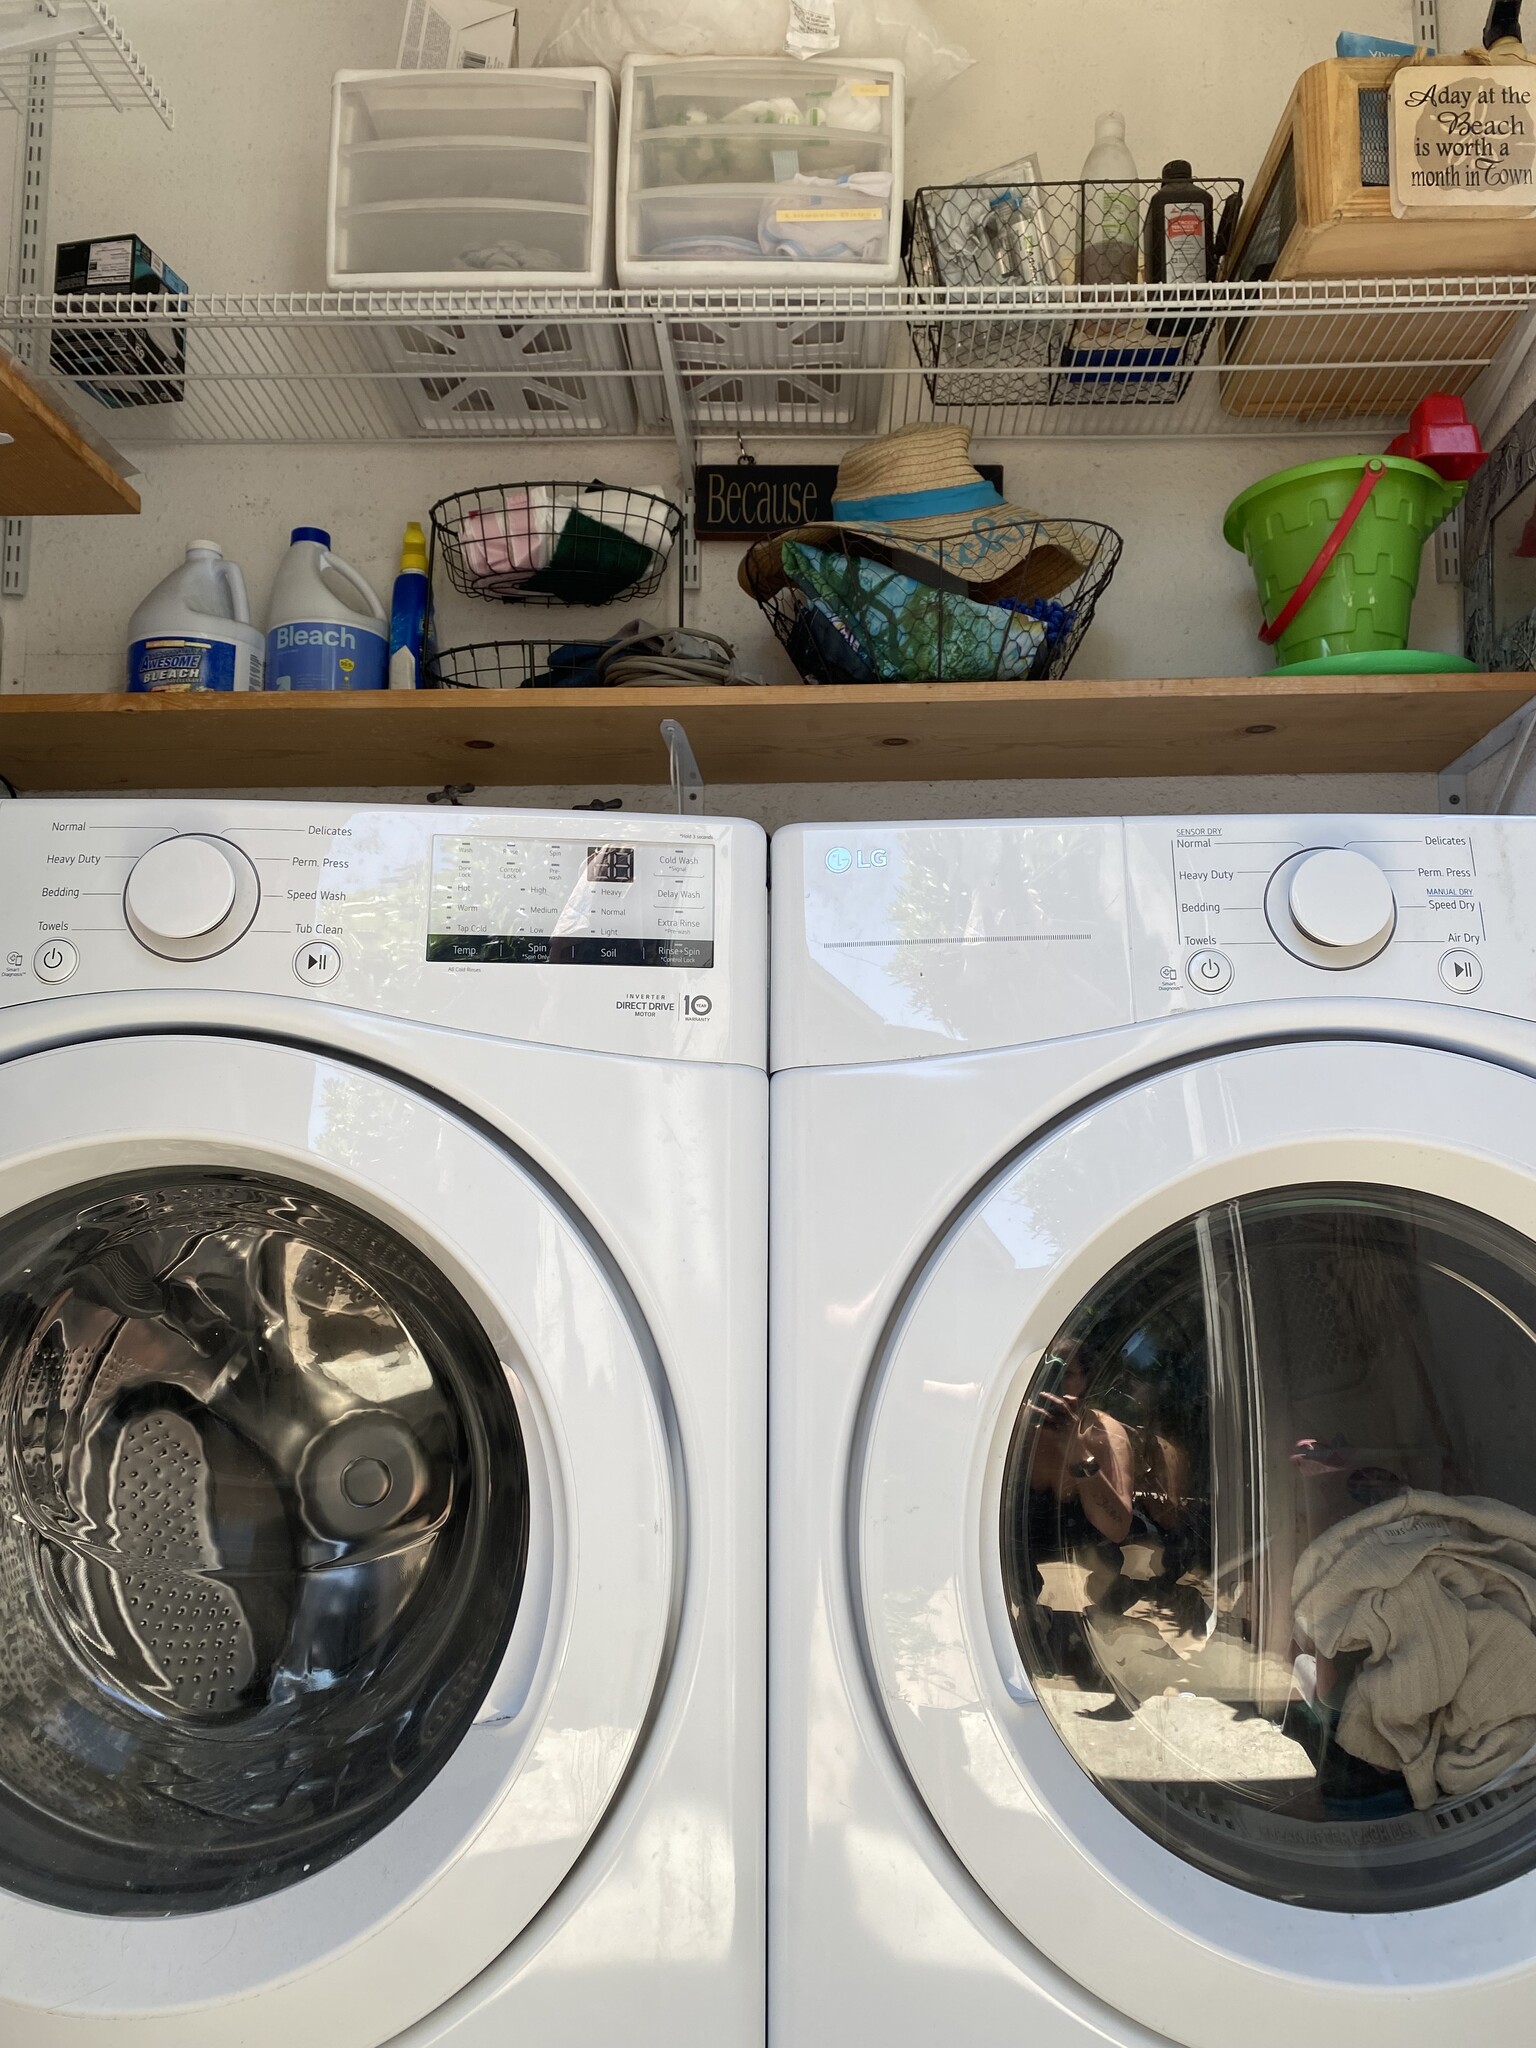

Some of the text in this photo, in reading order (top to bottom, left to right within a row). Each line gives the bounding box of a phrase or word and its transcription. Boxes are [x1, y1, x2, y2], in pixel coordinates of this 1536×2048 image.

[1405, 84, 1531, 108] A day at the
[1437, 111, 1525, 136] Beach
[1415, 137, 1510, 156] is worth a
[1411, 158, 1534, 187] month in Town
[706, 473, 818, 524] Because
[276, 625, 356, 650] Bleach
[141, 655, 201, 672] AWESOME
[143, 668, 200, 684] BLEACH
[52, 822, 86, 832] Normal
[308, 826, 353, 837] Delicates
[1176, 838, 1211, 848] Normal
[1425, 835, 1466, 846] Delicates
[47, 854, 102, 867] Heavy Duty
[292, 857, 350, 869] Perm. Press
[659, 856, 699, 865] Cold Wash
[856, 849, 888, 868] LG
[1179, 870, 1234, 881] Heavy Duty
[1418, 867, 1471, 878] Perm. Press
[42, 887, 80, 899] Bedding
[287, 890, 347, 902] Speed Wash
[531, 886, 547, 896] High
[601, 889, 622, 897] Heavy
[657, 890, 701, 899] Delay Wash
[530, 906, 558, 914] Medium
[1181, 903, 1220, 914] Bedding
[1428, 900, 1475, 912] Speed Dry
[601, 908, 626, 916] Normal
[38, 921, 69, 932] Towels
[657, 919, 701, 927] Extra Rinse
[295, 923, 344, 935] Tub Clean
[457, 925, 469, 933] Tap
[601, 928, 618, 937] Light
[1184, 936, 1217, 946] Towels
[1448, 933, 1480, 945] Air Dry
[453, 945, 478, 956] Temp.
[528, 943, 547, 953] Spin
[600, 948, 617, 958] Soil
[658, 946, 701, 957] Rinse+Spin
[616, 1001, 675, 1011] DIRECT DRIVE
[683, 994, 713, 1016] 10
